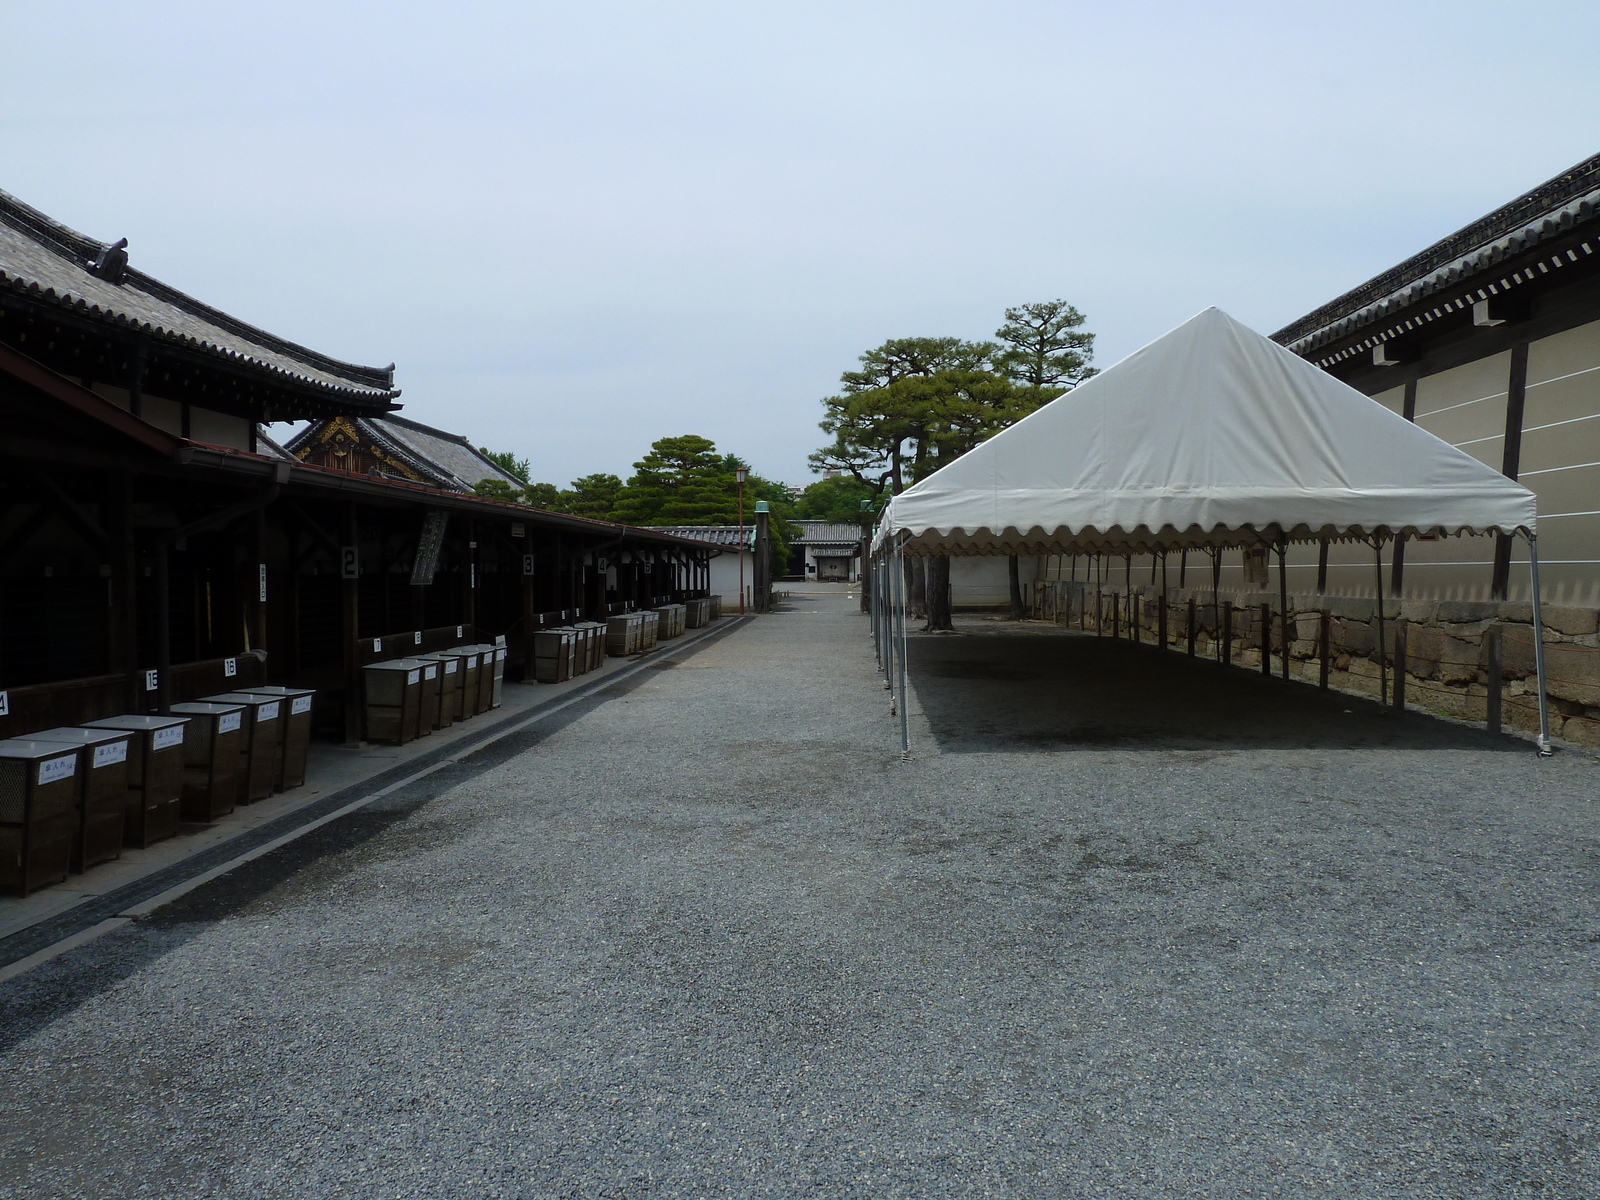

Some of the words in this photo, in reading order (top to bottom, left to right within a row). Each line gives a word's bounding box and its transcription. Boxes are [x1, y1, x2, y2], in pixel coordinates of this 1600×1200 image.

[345, 550, 355, 575] 2
[525, 557, 532, 572] 3
[600, 560, 605, 572] 4
[226, 660, 234, 674] 16
